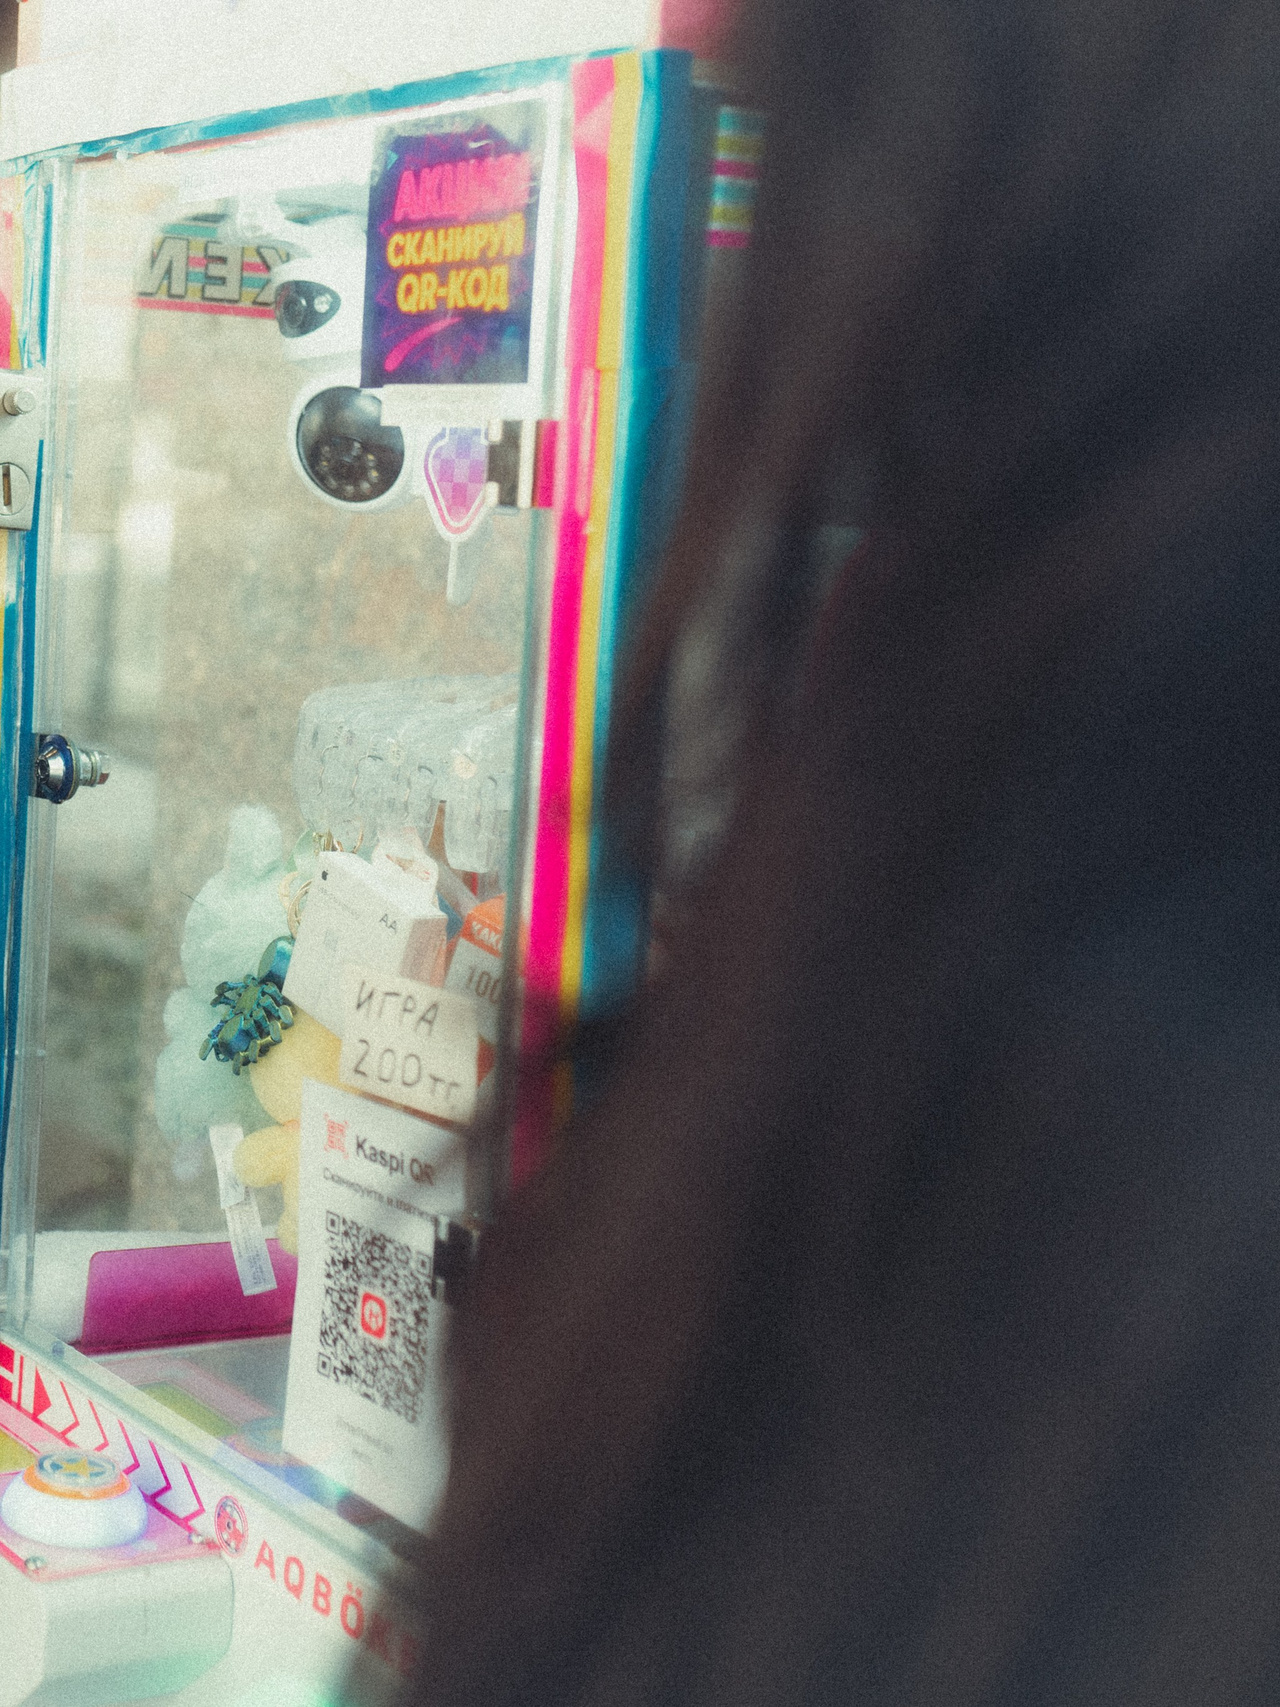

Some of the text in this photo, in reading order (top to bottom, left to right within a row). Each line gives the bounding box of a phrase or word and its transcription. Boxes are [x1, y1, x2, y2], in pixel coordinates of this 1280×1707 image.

[387, 213, 525, 268] СКАНИРУЙ
[397, 264, 509, 314] QR-КОД
[356, 980, 439, 1036] ИГРА
[355, 1134, 435, 1187] Kaspi QR
